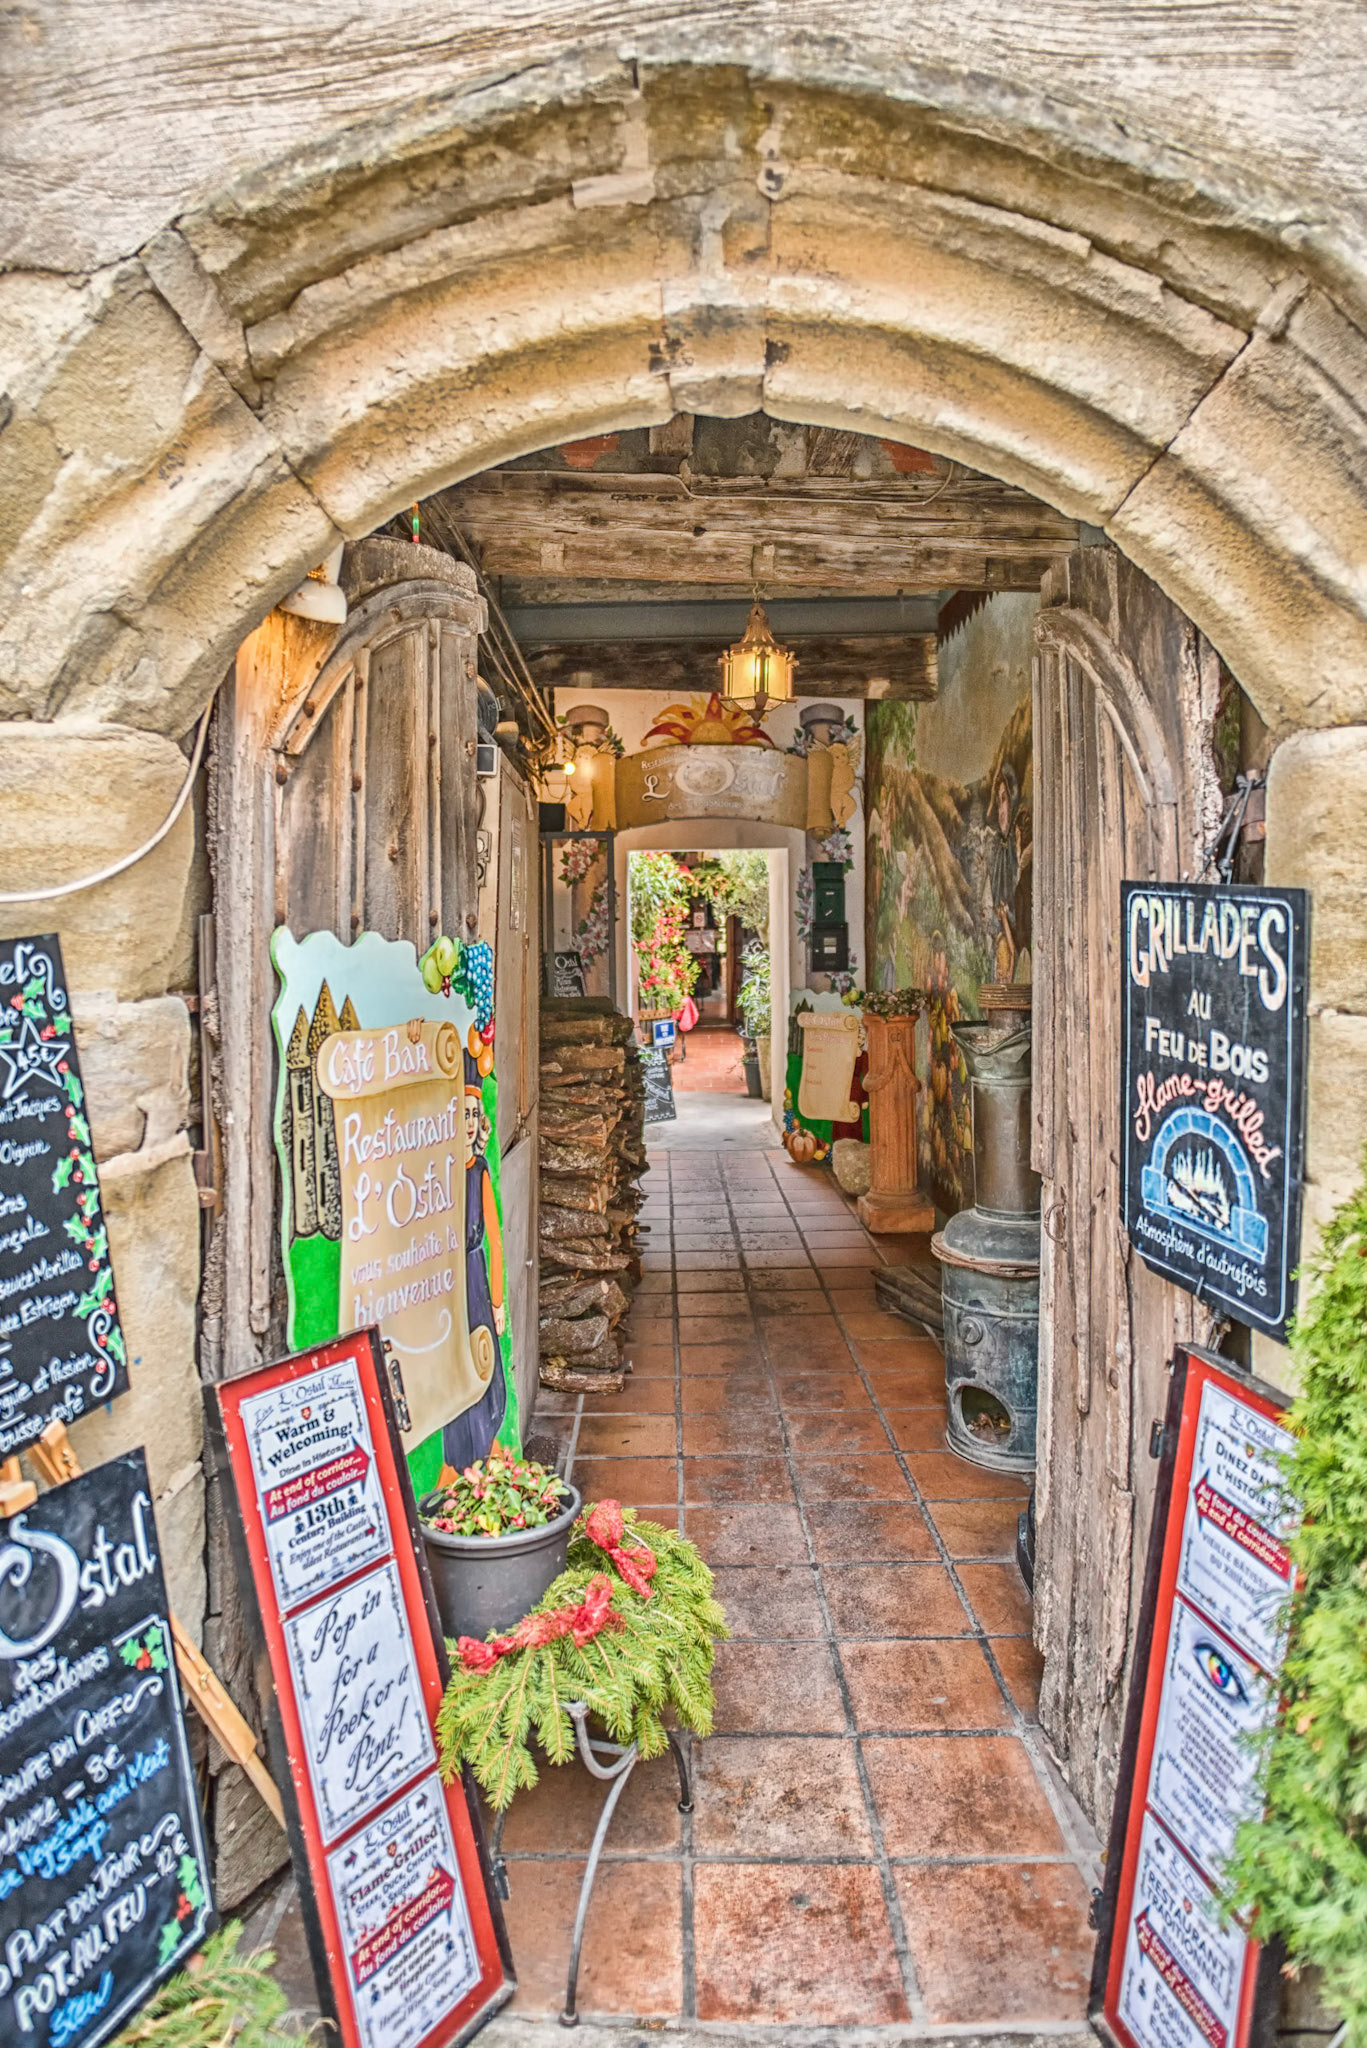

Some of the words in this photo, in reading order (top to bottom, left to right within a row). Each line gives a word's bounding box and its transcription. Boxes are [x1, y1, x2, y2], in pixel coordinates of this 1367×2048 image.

[1130, 895, 1288, 1012] GRILLADES
[1187, 988, 1212, 1020] AU
[328, 1038, 375, 1094] Café
[1145, 1015, 1185, 1062] FEU
[1188, 1039, 1209, 1068] DE
[1209, 1027, 1270, 1084] BOIS
[1134, 1070, 1283, 1180] flame-grilled
[348, 1153, 456, 1243] L'Ostal
[351, 1258, 383, 1286] vous
[386, 1229, 443, 1276] souhaite
[446, 1222, 460, 1253] la
[1135, 1213, 1196, 1259] Atmosphère
[1196, 1242, 1268, 1297] d'autrefois
[354, 1266, 455, 1330] bienvenue
[267, 1421, 354, 1468] Welcoming!
[275, 1415, 320, 1443] Warm
[322, 1407, 336, 1423] &
[1215, 1442, 1248, 1475] DINEZ
[268, 1488, 282, 1504] At
[282, 1479, 302, 1496] end
[303, 1472, 316, 1489] of
[269, 1502, 285, 1518] Au
[284, 1491, 310, 1512] fond
[310, 1482, 324, 1498] du
[305, 1494, 345, 1527] 13th
[1211, 1493, 1232, 1519] fond
[288, 1523, 326, 1549] Century
[327, 1502, 366, 1529] Building
[311, 1600, 356, 1661] Pop
[361, 1589, 382, 1618] in
[15, 1645, 57, 1693] des
[325, 1656, 363, 1718] for
[367, 1642, 380, 1664] a
[316, 1682, 377, 1762] Peek
[374, 1681, 394, 1705] or
[399, 1664, 410, 1686] a
[50, 1734, 79, 1768] DU
[84, 1743, 126, 1784] 8€
[344, 1698, 410, 1789] Pint!
[95, 1772, 132, 1815] and
[126, 1736, 171, 1790] Meat
[348, 1827, 438, 1905] Flame-Grilled
[6, 1907, 68, 1979] PLAT
[66, 1883, 100, 1924] DU
[357, 1946, 369, 1964] At
[370, 1928, 390, 1952] end
[391, 1918, 403, 1938] of
[358, 1960, 373, 1980] Au
[374, 1938, 398, 1968] fond
[398, 1925, 411, 1943] du
[1146, 1889, 1222, 1994] TRADITIONNEL
[1148, 1872, 1226, 1978] RESTAURANT
[386, 1944, 418, 1977] Cooked
[1156, 1983, 1193, 2041] English
